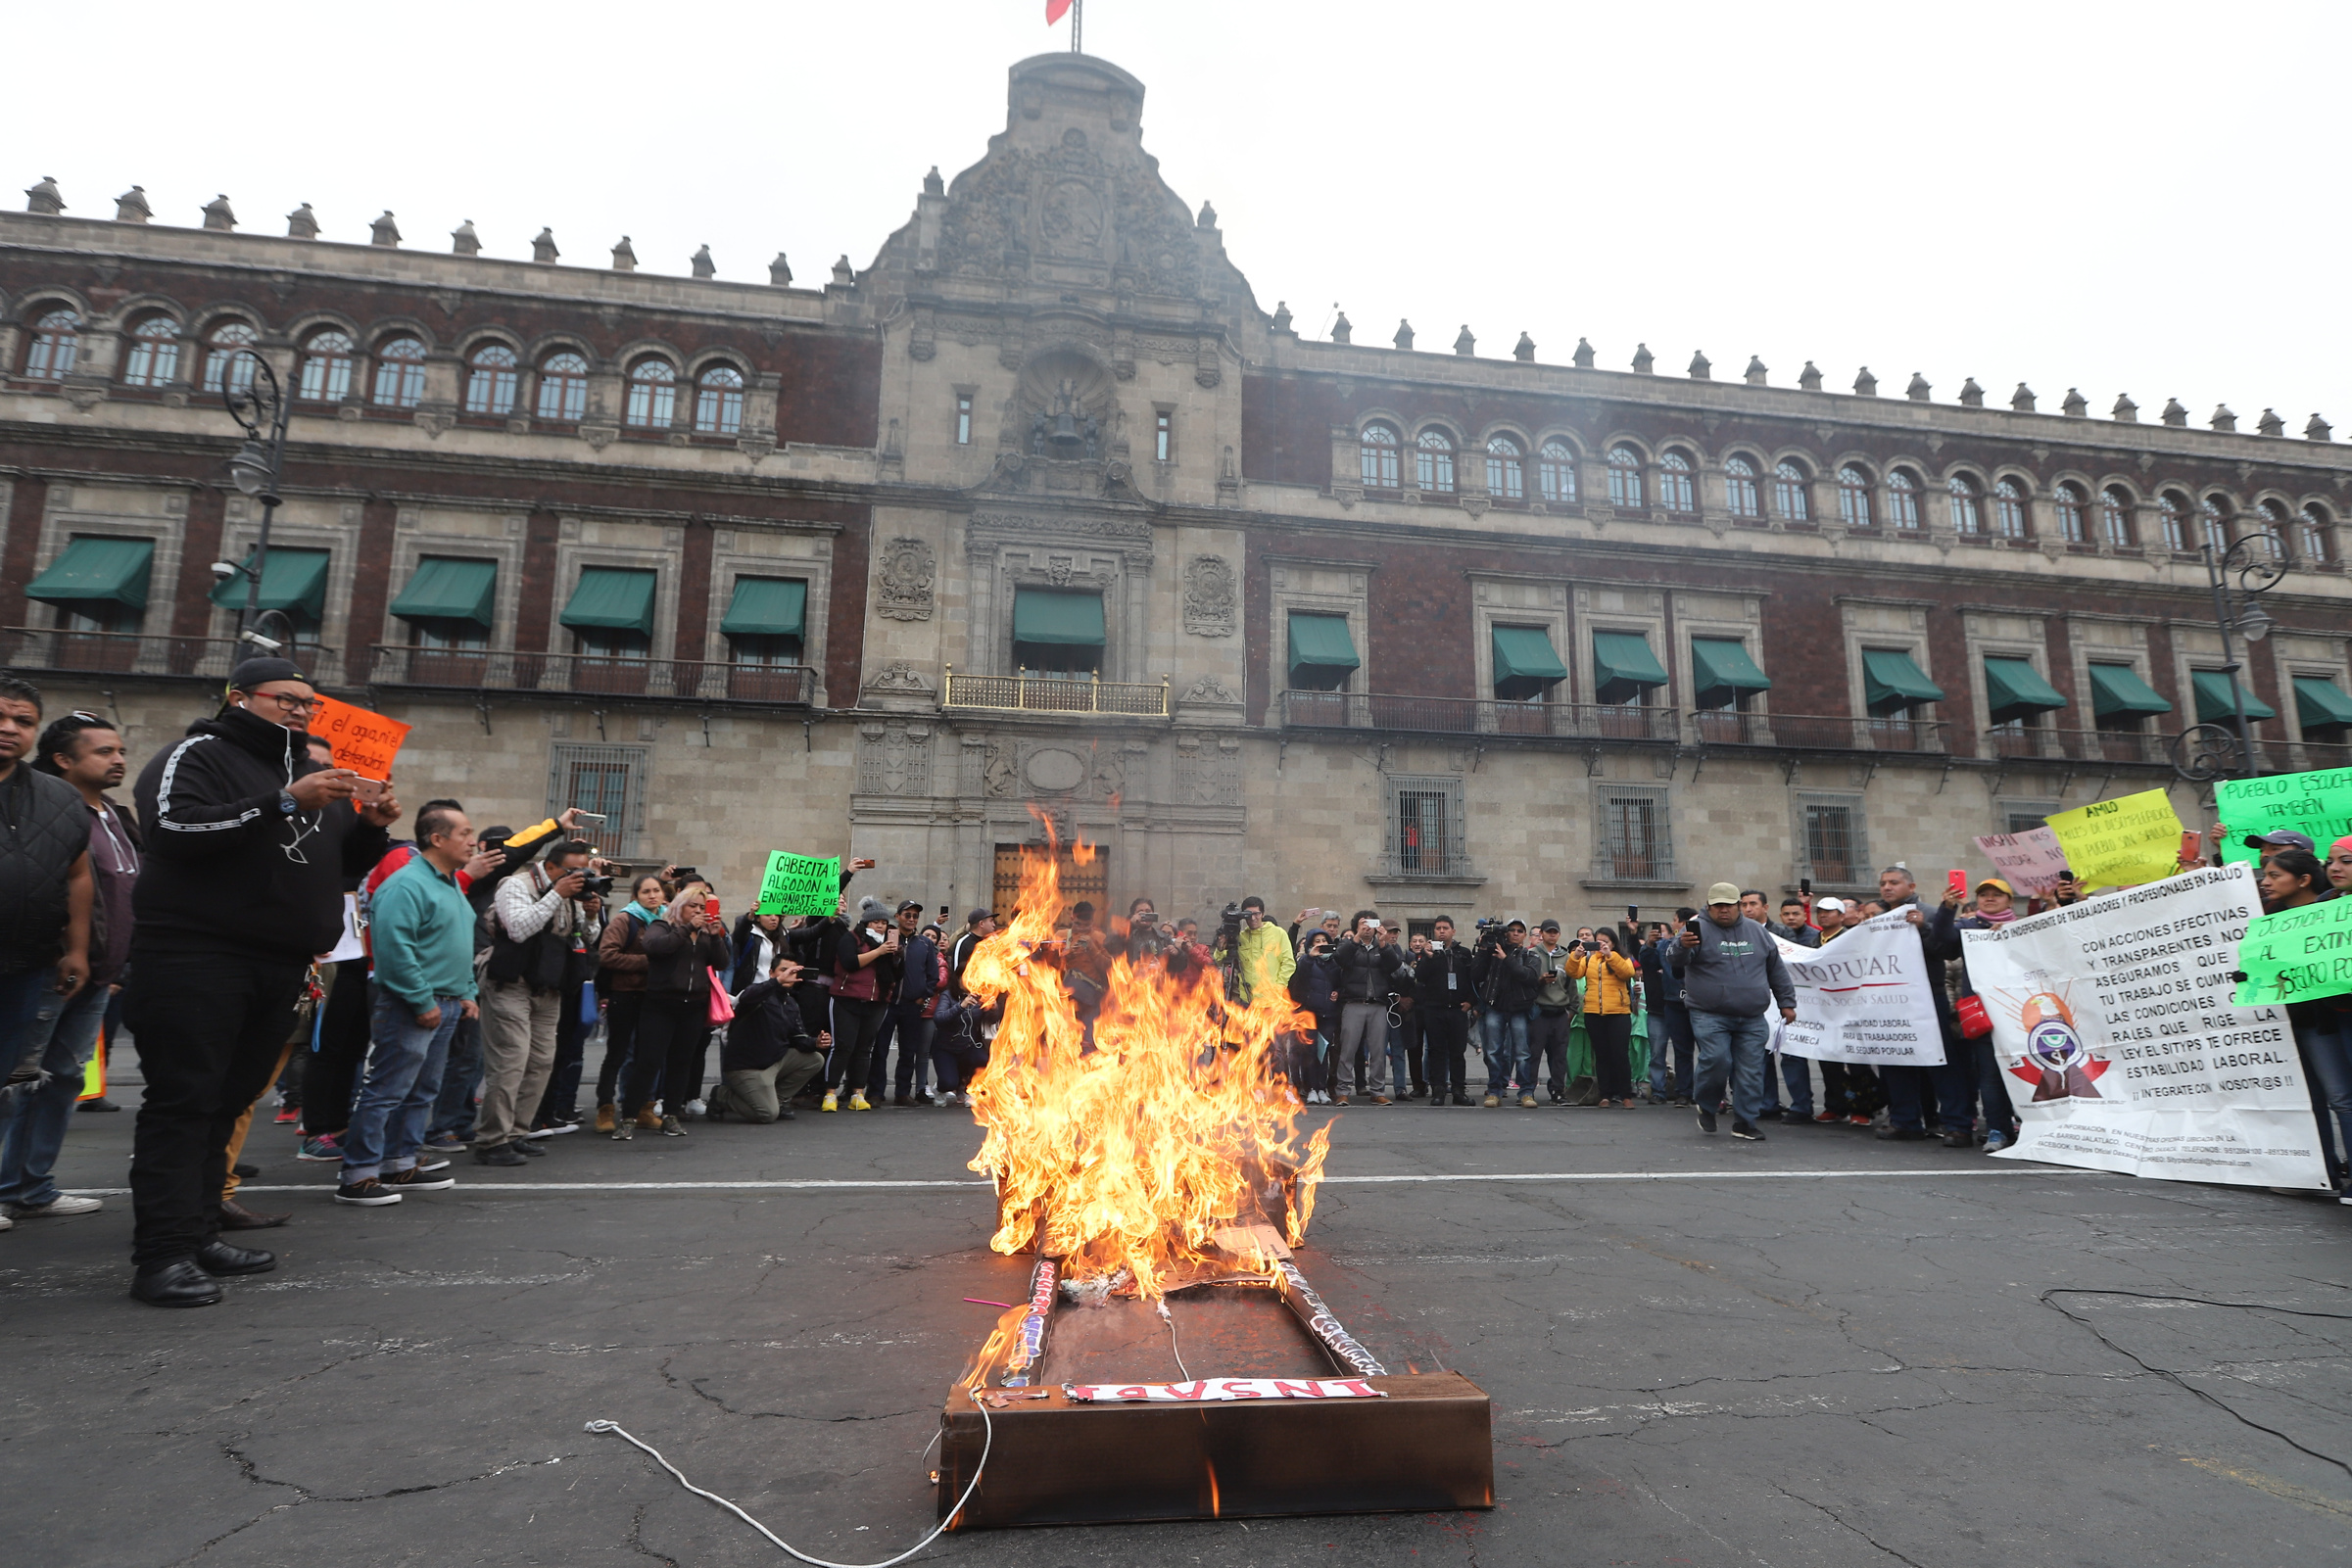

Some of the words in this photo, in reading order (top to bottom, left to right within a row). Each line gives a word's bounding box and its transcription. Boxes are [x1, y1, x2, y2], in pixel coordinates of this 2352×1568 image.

[331, 714, 351, 733] el
[2225, 780, 2287, 799] PUEBLO
[2086, 801, 2119, 819] AMLO
[2296, 821, 2324, 837] TU
[776, 855, 829, 879] CABECITA
[2010, 916, 2057, 937] INDEPENDIENTE
[2057, 913, 2067, 925] DE
[2067, 898, 2121, 921] TRABAJADORES
[2121, 896, 2128, 907] Y
[2128, 878, 2194, 906] PROFESIONALES
[2194, 874, 2207, 888] EN
[2207, 867, 2243, 885] SALUD
[2082, 940, 2107, 954] CON
[2108, 924, 2172, 948] ACCIONES
[2174, 906, 2250, 932] EFECTIVAS
[2087, 960, 2095, 971] Y
[2102, 934, 2213, 969] TRANSPARENTES
[2260, 944, 2277, 961] AL
[1792, 954, 1903, 982] POPUAR
[2095, 961, 2181, 988] ASEGURAMOS
[2197, 952, 2230, 968] QUE
[1870, 993, 1909, 1005] SALUD
[2099, 994, 2115, 1007] TU
[2119, 982, 2173, 1003] TRABAJO
[2177, 978, 2192, 991] SE
[2105, 1011, 2131, 1024] LAS
[2135, 995, 2216, 1020] CONDICIONES
[1879, 1020, 1912, 1028] LABORAL
[2112, 1026, 2153, 1043] RALES
[2159, 1021, 2188, 1035] QUE
[2201, 1014, 2237, 1029] RIGE
[2254, 1008, 2279, 1022] LA
[1863, 1032, 1918, 1042] TRABAJADORES
[2145, 1045, 2161, 1058] EL
[2162, 1038, 2202, 1056] SITYPS
[2206, 1036, 2221, 1050] TE
[2223, 1028, 2282, 1047] OFRECE
[1855, 1045, 1881, 1055] SEGURO
[1881, 1046, 1916, 1056] POPULAR
[2127, 1060, 2204, 1079] ESTABILIDAD
[2213, 1051, 2289, 1069] LABORAL.
[2219, 1076, 2282, 1092] NOSOTR@S
